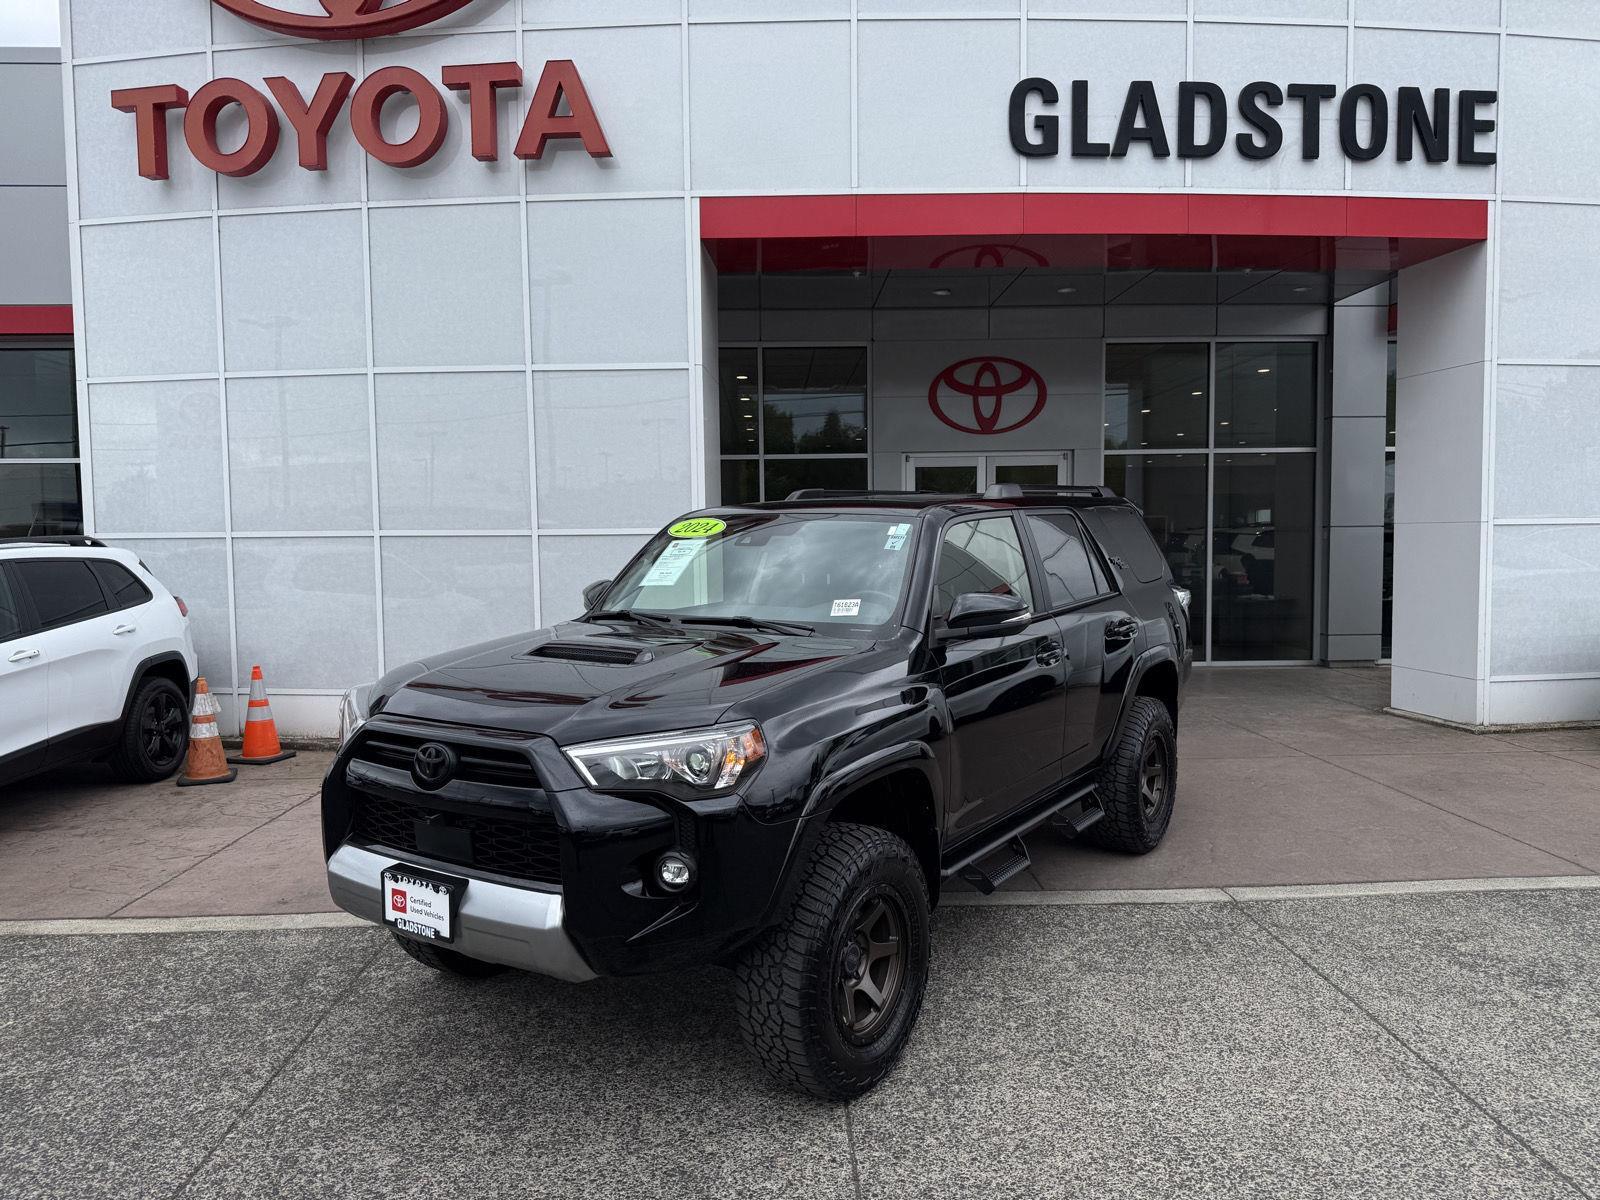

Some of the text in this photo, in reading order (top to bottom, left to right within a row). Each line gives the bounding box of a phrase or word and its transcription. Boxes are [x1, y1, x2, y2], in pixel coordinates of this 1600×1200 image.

[110, 60, 613, 181] TOYOTA
[1009, 77, 1498, 166] GLADSTONE
[397, 875, 433, 891] TOYOTA
[409, 896, 432, 908] Certified
[409, 906, 445, 921] Used Vehicles
[397, 917, 436, 939] GLADSTONE
